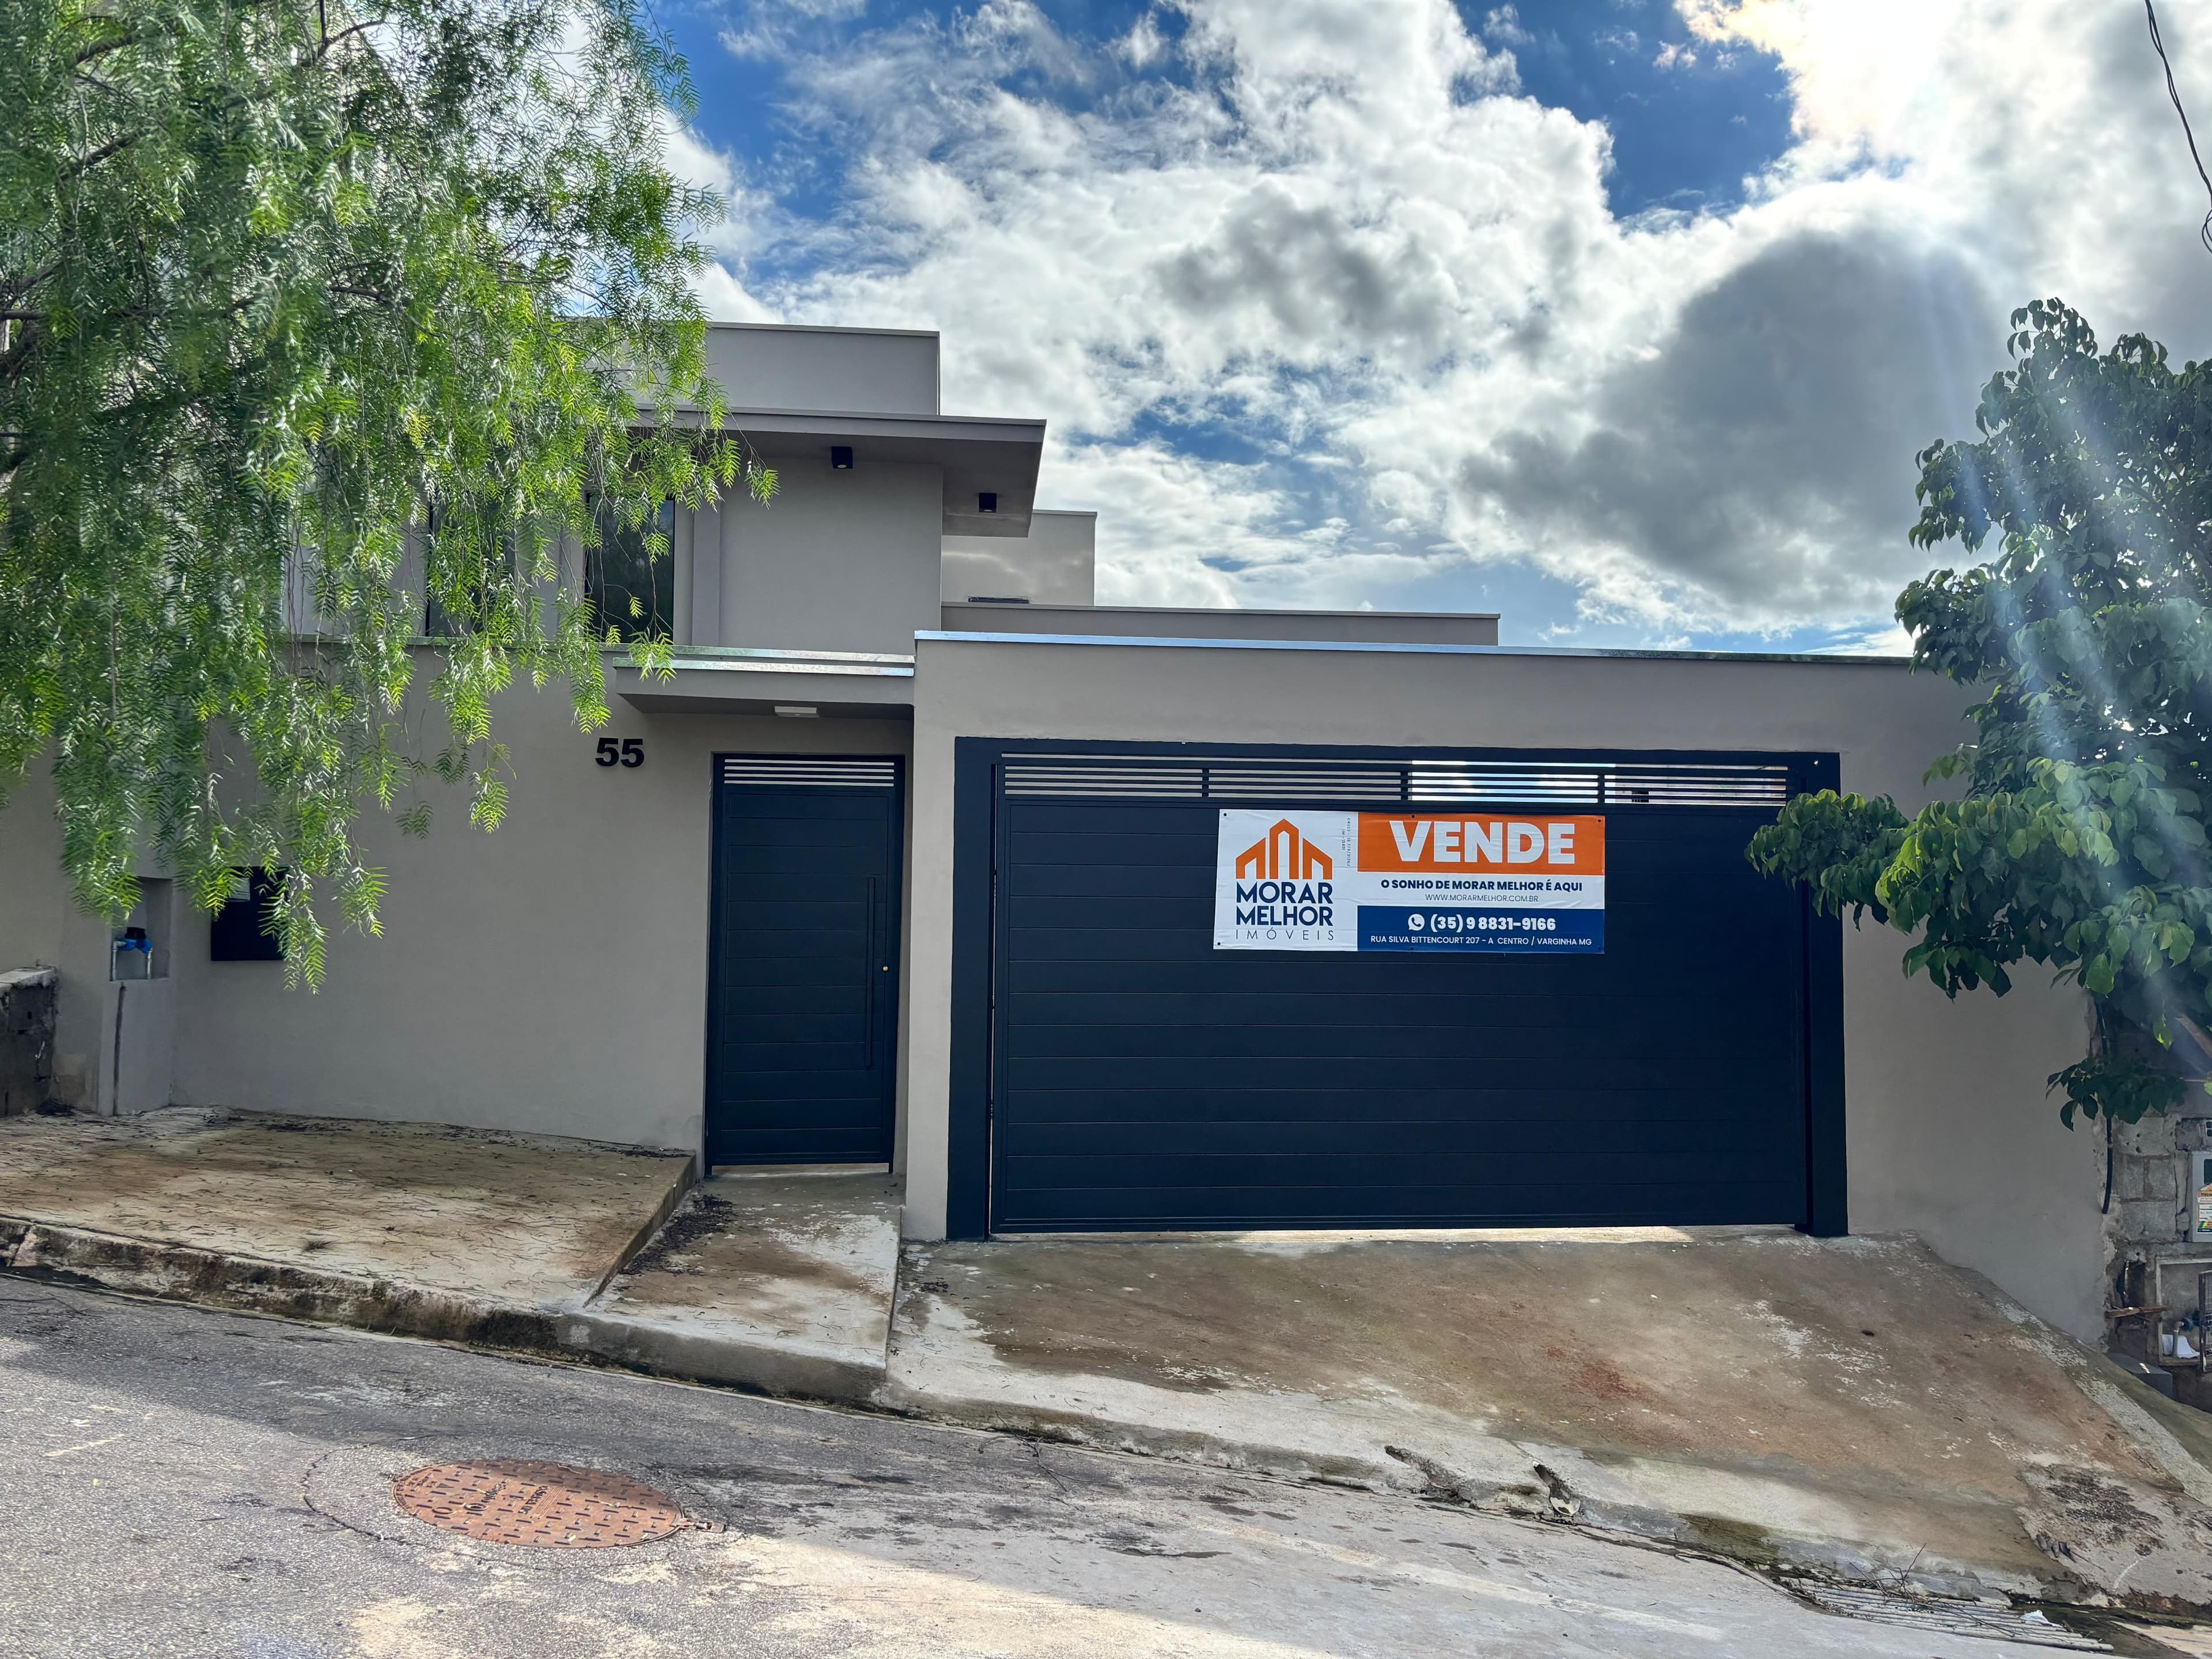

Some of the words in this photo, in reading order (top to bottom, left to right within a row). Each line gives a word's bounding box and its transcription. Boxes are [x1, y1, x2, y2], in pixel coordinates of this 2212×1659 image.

[595, 737, 645, 768] 55
[1389, 820, 1575, 864] VENDE
[1236, 881, 1334, 904] MORAR
[1381, 879, 1390, 889] O
[1391, 880, 1434, 889] SONHO
[1435, 880, 1450, 889] DE
[1452, 880, 1495, 890] MORAR
[1497, 881, 1544, 891] MELHOR
[1546, 878, 1552, 891] É
[1554, 882, 1583, 892] AQUI
[1425, 893, 1539, 903] WWW.MORARMELHOR.COM.BR
[1236, 905, 1334, 927] MELHOR
[1430, 914, 1464, 933] (35)
[1466, 916, 1476, 930] 9
[1478, 916, 1556, 931] 8831-9166
[1236, 927, 1334, 941] IMÓVEIS
[1388, 935, 1410, 944] SILVA
[1531, 935, 1535, 946] /
